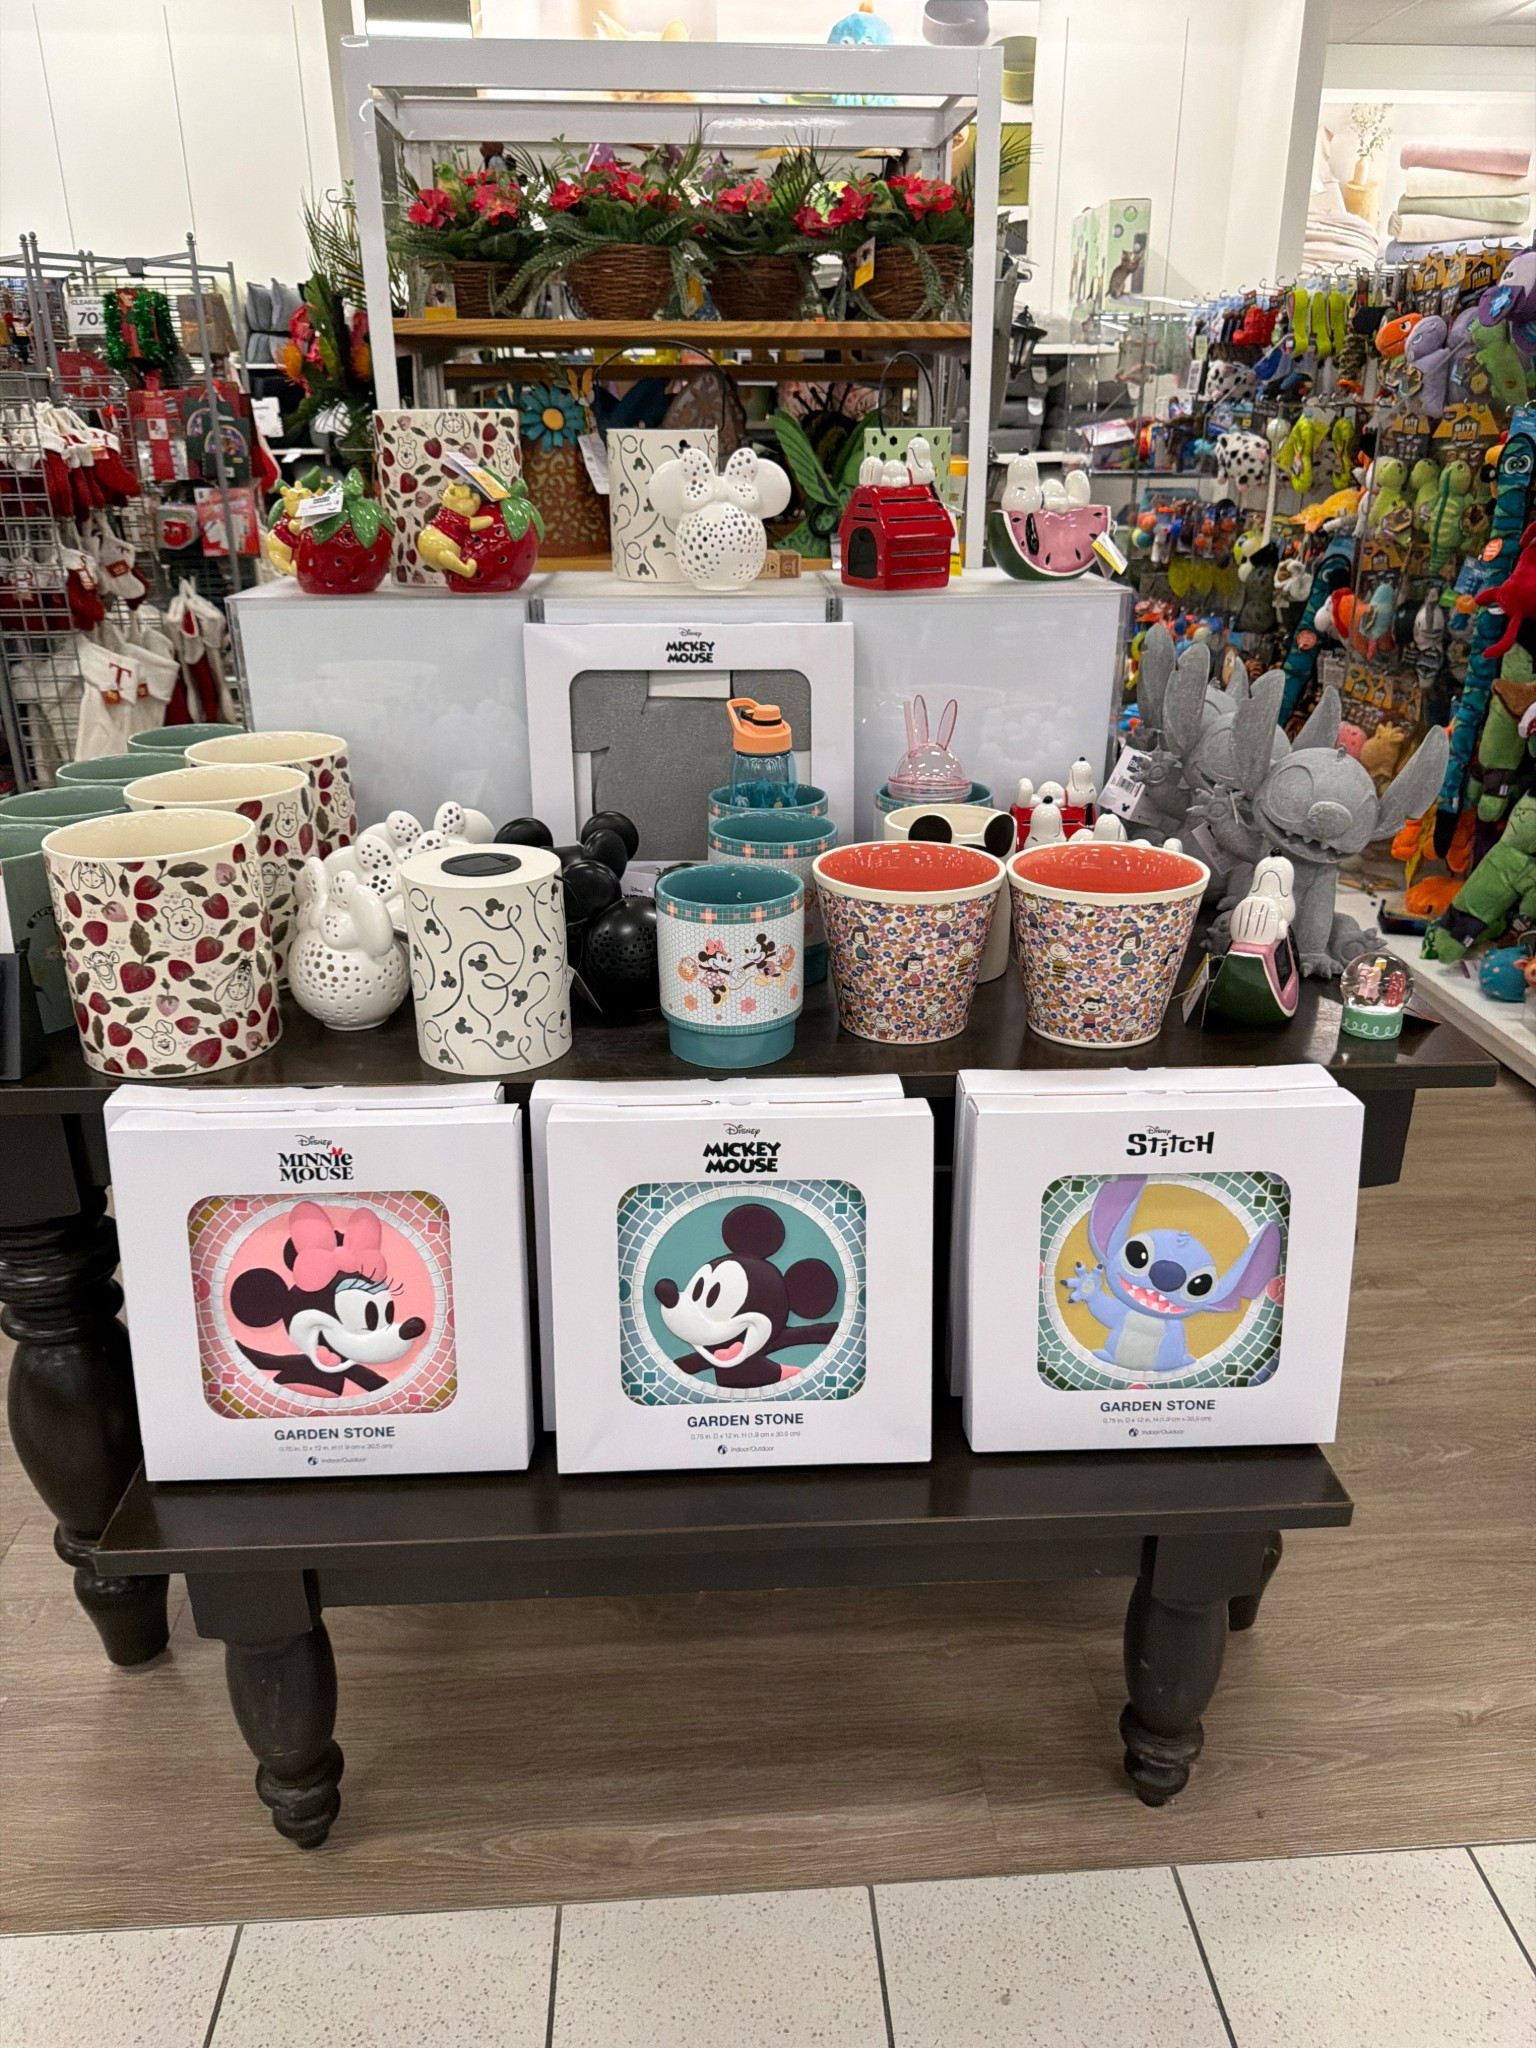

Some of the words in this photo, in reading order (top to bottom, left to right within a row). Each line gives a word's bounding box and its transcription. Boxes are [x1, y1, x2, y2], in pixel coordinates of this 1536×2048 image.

[665, 641, 715, 652] MICKEY
[667, 652, 714, 663] MOUSE
[723, 1122, 761, 1138] Disney
[1145, 1125, 1172, 1136] Disney
[295, 1134, 333, 1149] Disney
[702, 1141, 782, 1158] MICKEY
[705, 1157, 778, 1174] MOUSE
[279, 1166, 354, 1184] MOUSE
[1100, 1400, 1162, 1412] GARDEN
[1166, 1399, 1216, 1411] STONE
[687, 1415, 750, 1428] GARDEN
[754, 1413, 804, 1425] STONE
[274, 1428, 339, 1441] GARDEN
[344, 1426, 396, 1438] STONE
